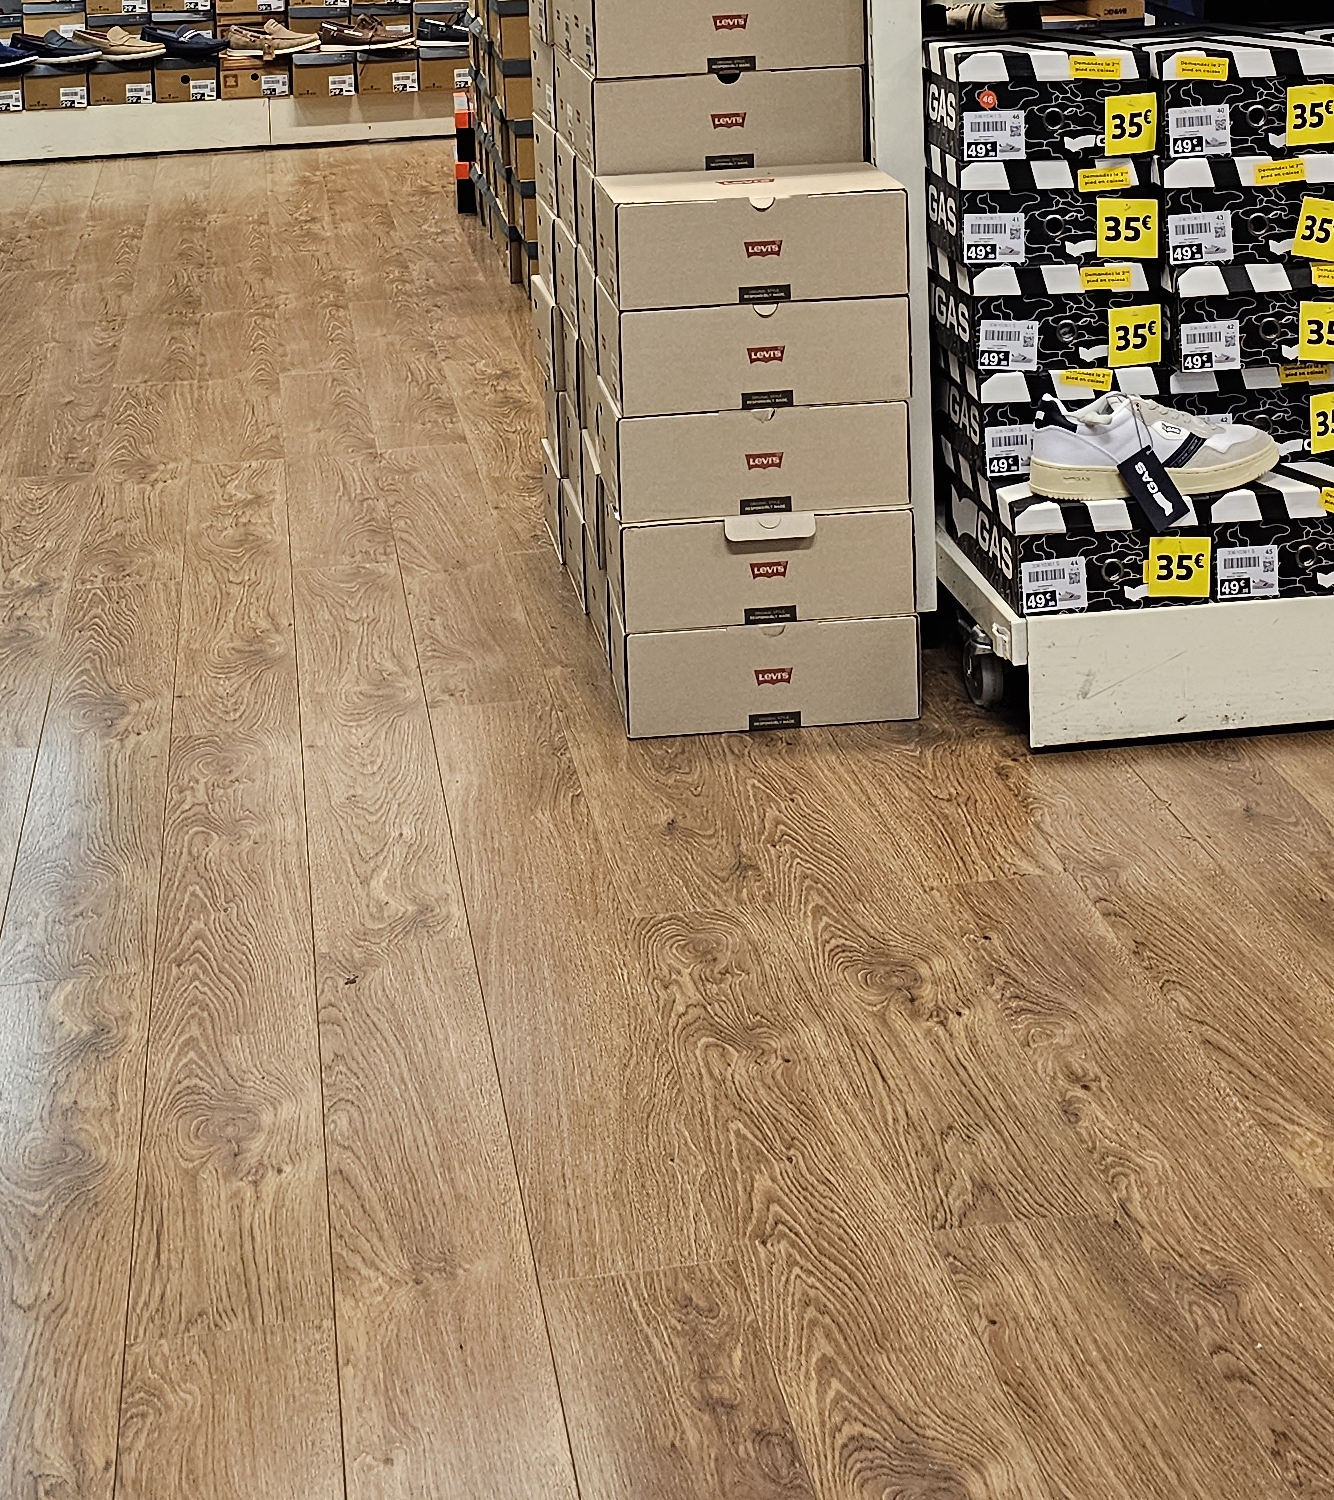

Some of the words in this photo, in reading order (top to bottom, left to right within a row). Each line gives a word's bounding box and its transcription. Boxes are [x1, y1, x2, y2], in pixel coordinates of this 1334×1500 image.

[928, 83, 957, 131] GAS
[1112, 109, 1151, 139] 35€
[1293, 100, 1333, 129] 35€
[928, 184, 957, 237] GAS
[1105, 215, 1151, 241] 35€
[934, 289, 970, 343] GAS
[1116, 321, 1156, 351] 35€
[948, 385, 981, 446] GAS
[977, 509, 1013, 580] GAS
[1157, 554, 1204, 580] 35€
